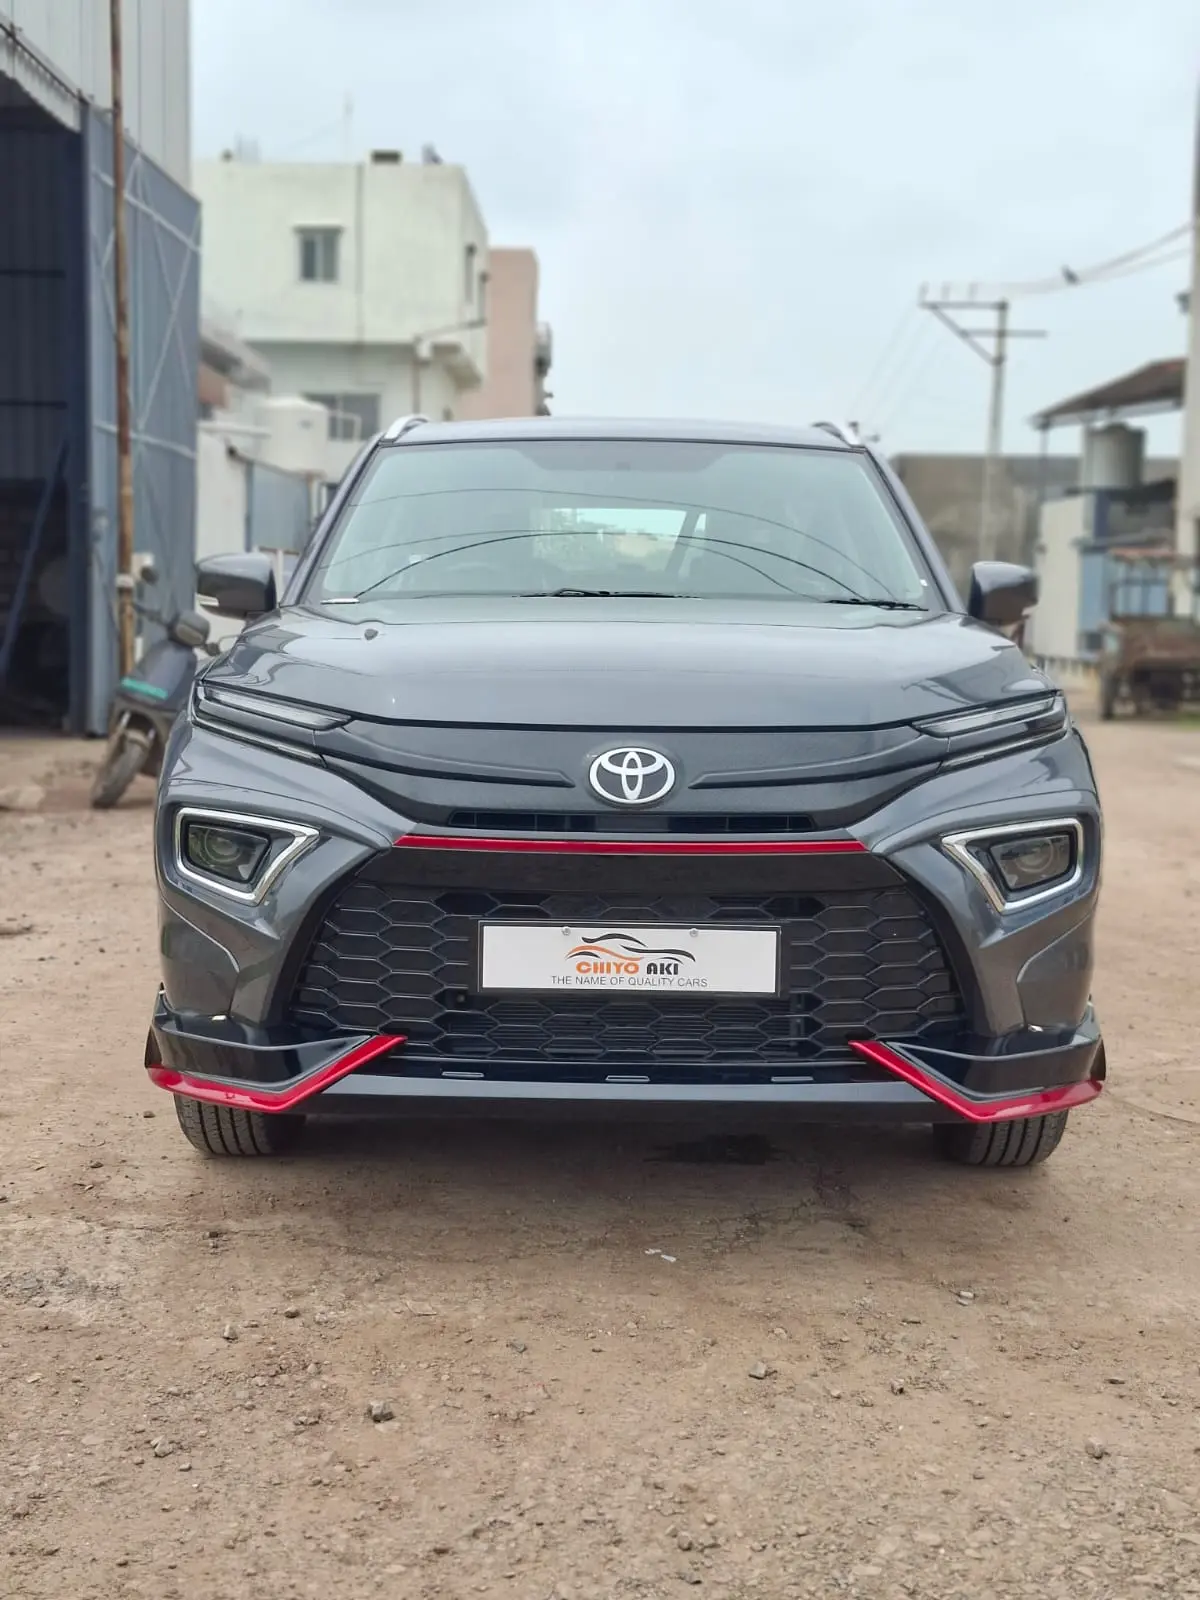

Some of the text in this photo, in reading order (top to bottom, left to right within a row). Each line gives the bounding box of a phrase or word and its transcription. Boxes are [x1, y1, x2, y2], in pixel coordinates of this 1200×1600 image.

[576, 961, 679, 975] CHIYO AKI
[552, 975, 708, 987] THE NAME OF QUALITY CARS
